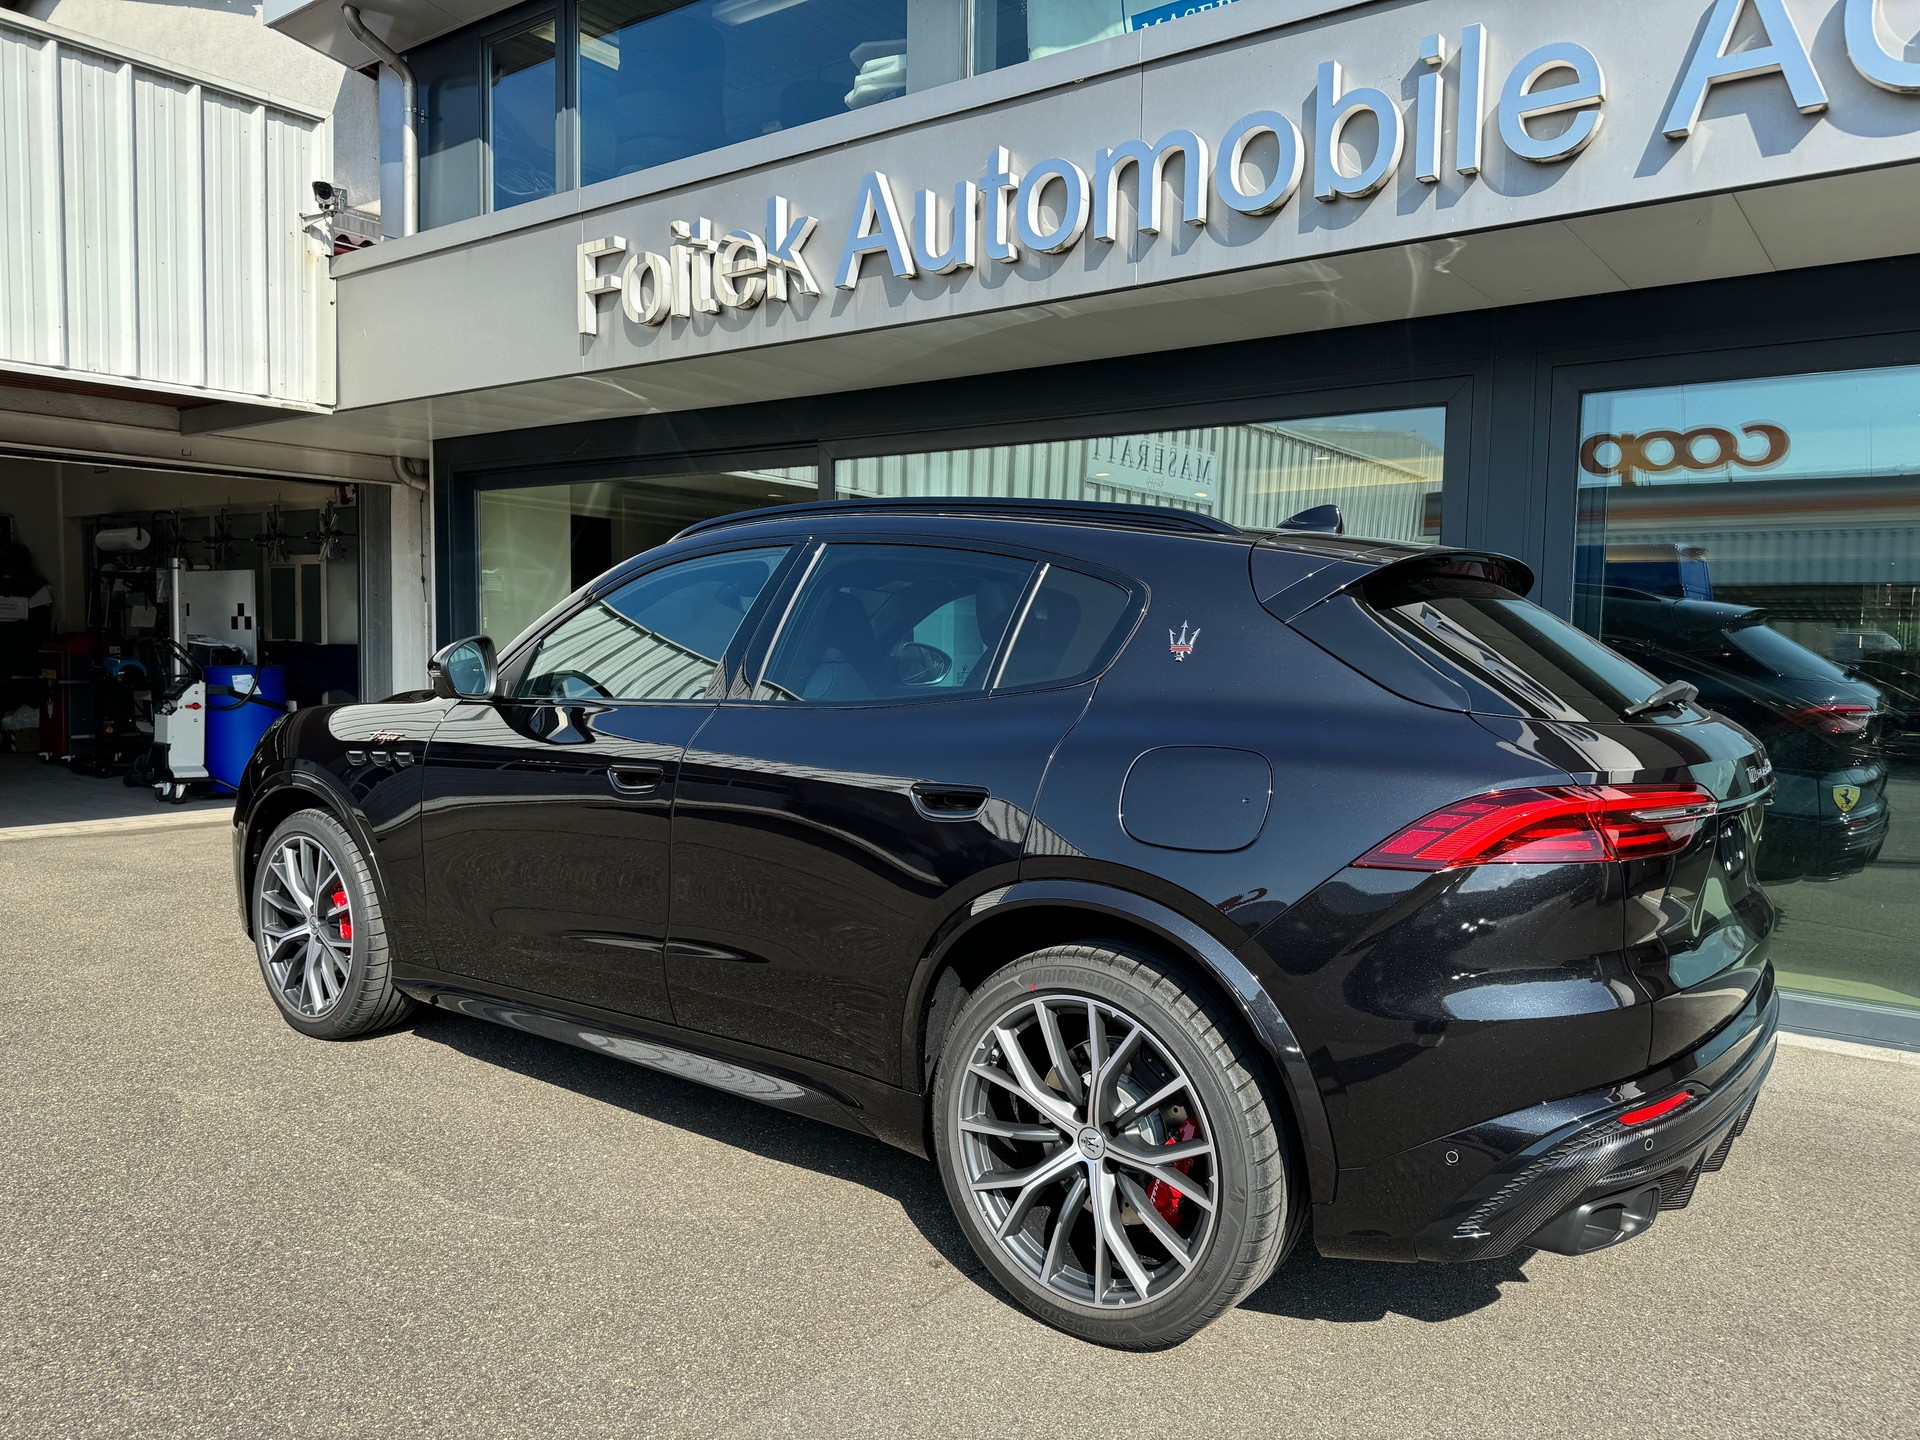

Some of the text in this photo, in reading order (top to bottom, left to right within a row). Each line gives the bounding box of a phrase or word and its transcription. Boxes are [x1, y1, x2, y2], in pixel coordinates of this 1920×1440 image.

[577, 195, 821, 336] Foitek
[834, 24, 1605, 290] Automobile
[1031, 968, 1136, 1001] BRIDGESTONE
